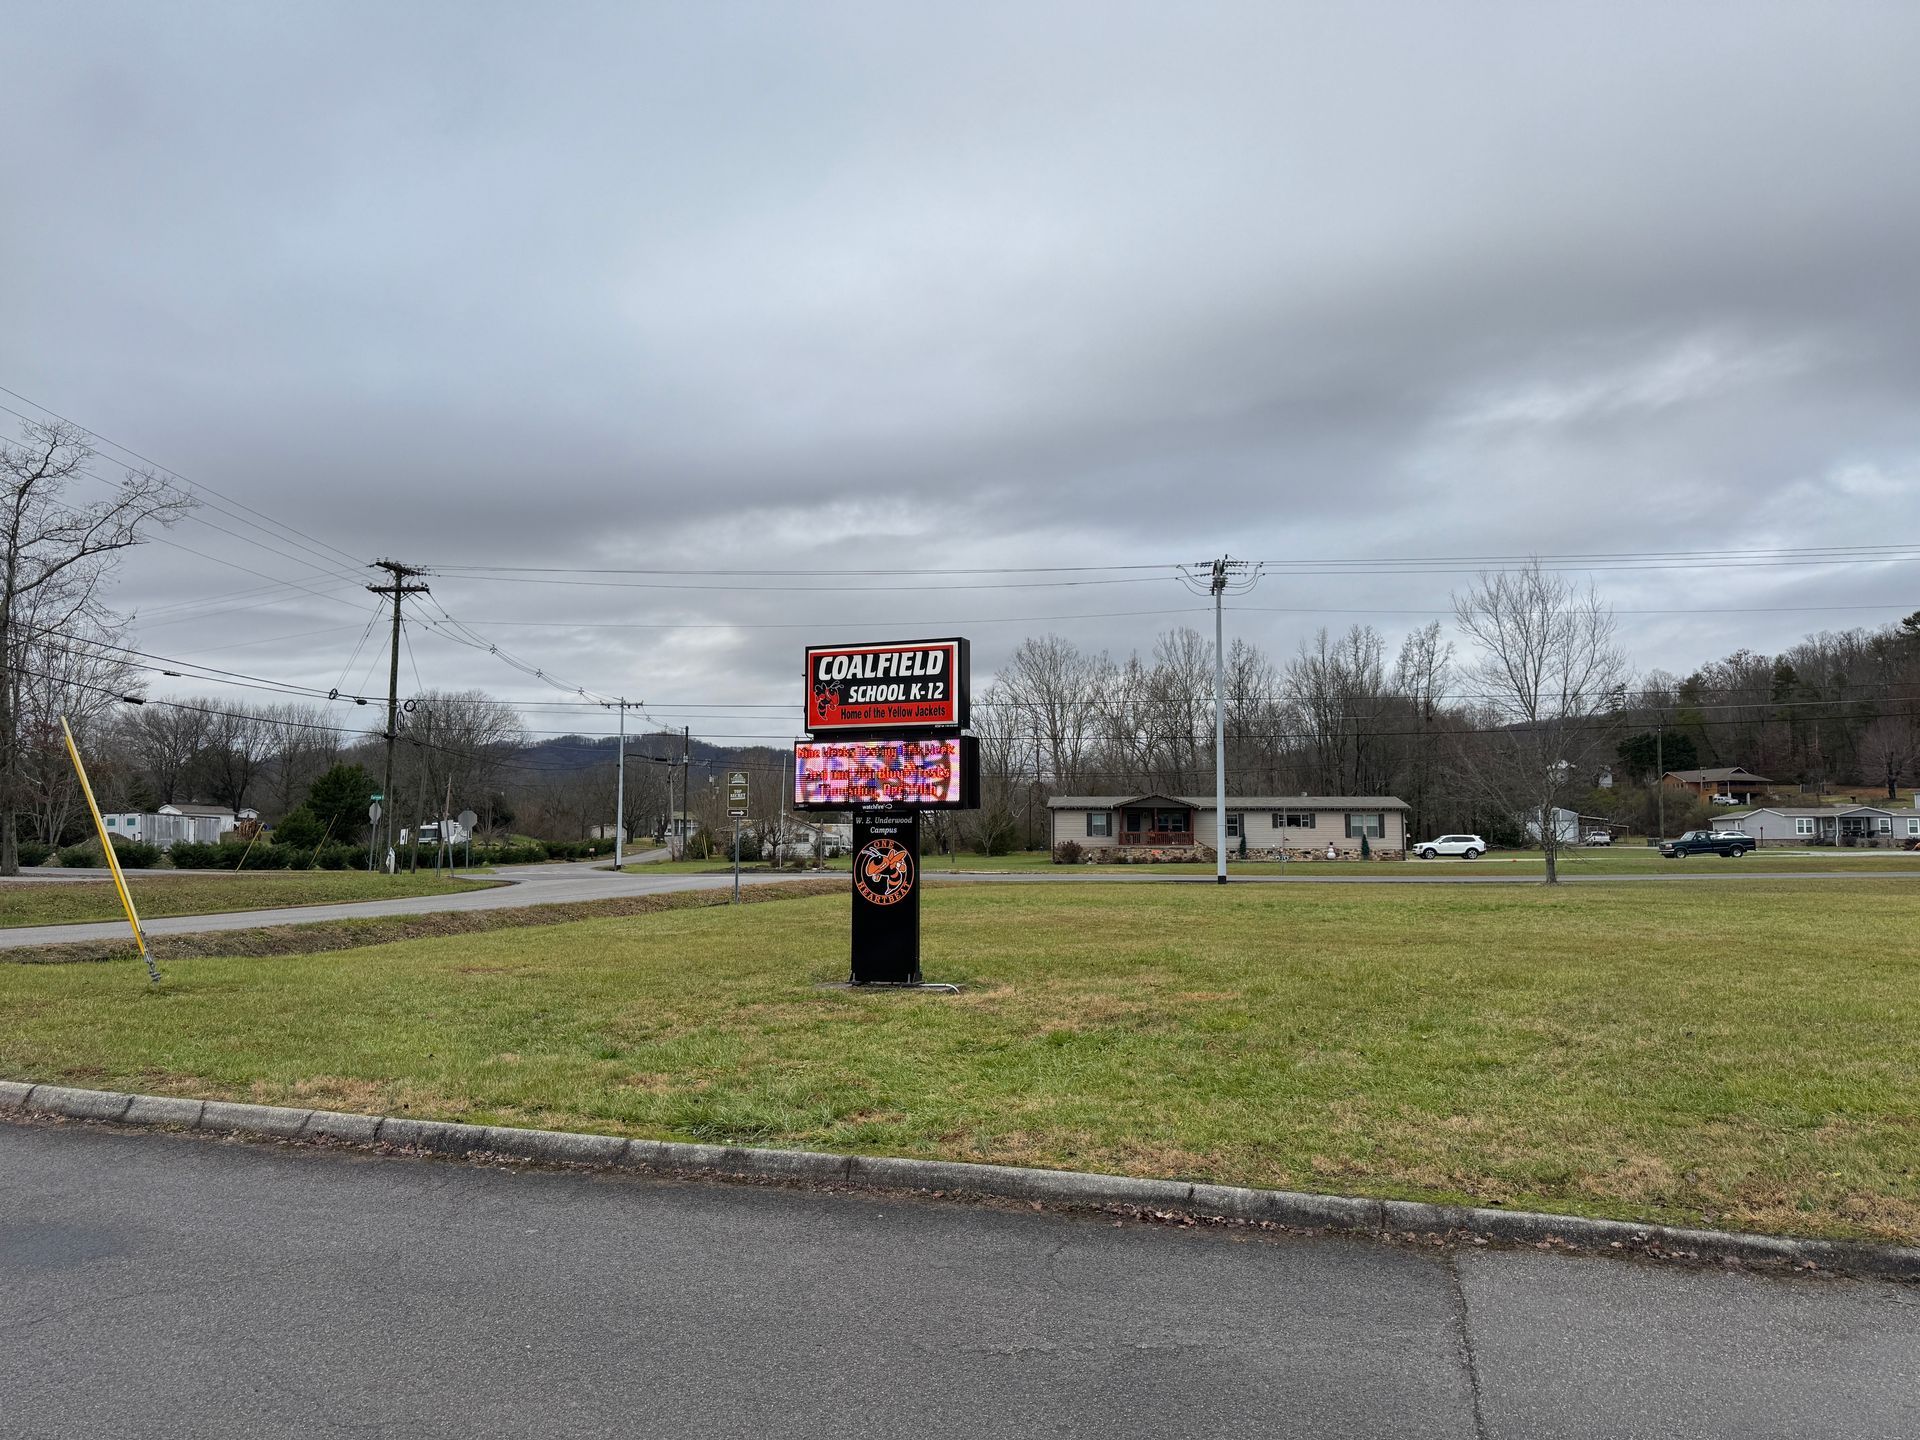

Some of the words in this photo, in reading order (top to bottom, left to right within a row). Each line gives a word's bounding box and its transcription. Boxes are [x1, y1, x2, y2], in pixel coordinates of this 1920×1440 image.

[818, 650, 944, 680] COALFIELD
[848, 684, 906, 703] SCHOOL
[909, 682, 944, 700] K-12
[840, 708, 862, 720] Home
[864, 707, 872, 719] of
[874, 706, 885, 718] the
[888, 705, 912, 718] Yellow
[915, 704, 946, 717] Jackets
[875, 816, 913, 824] Underwood
[870, 826, 898, 835] Campus
[873, 841, 895, 849] ONE
[857, 881, 910, 904] HEARTBEAT
